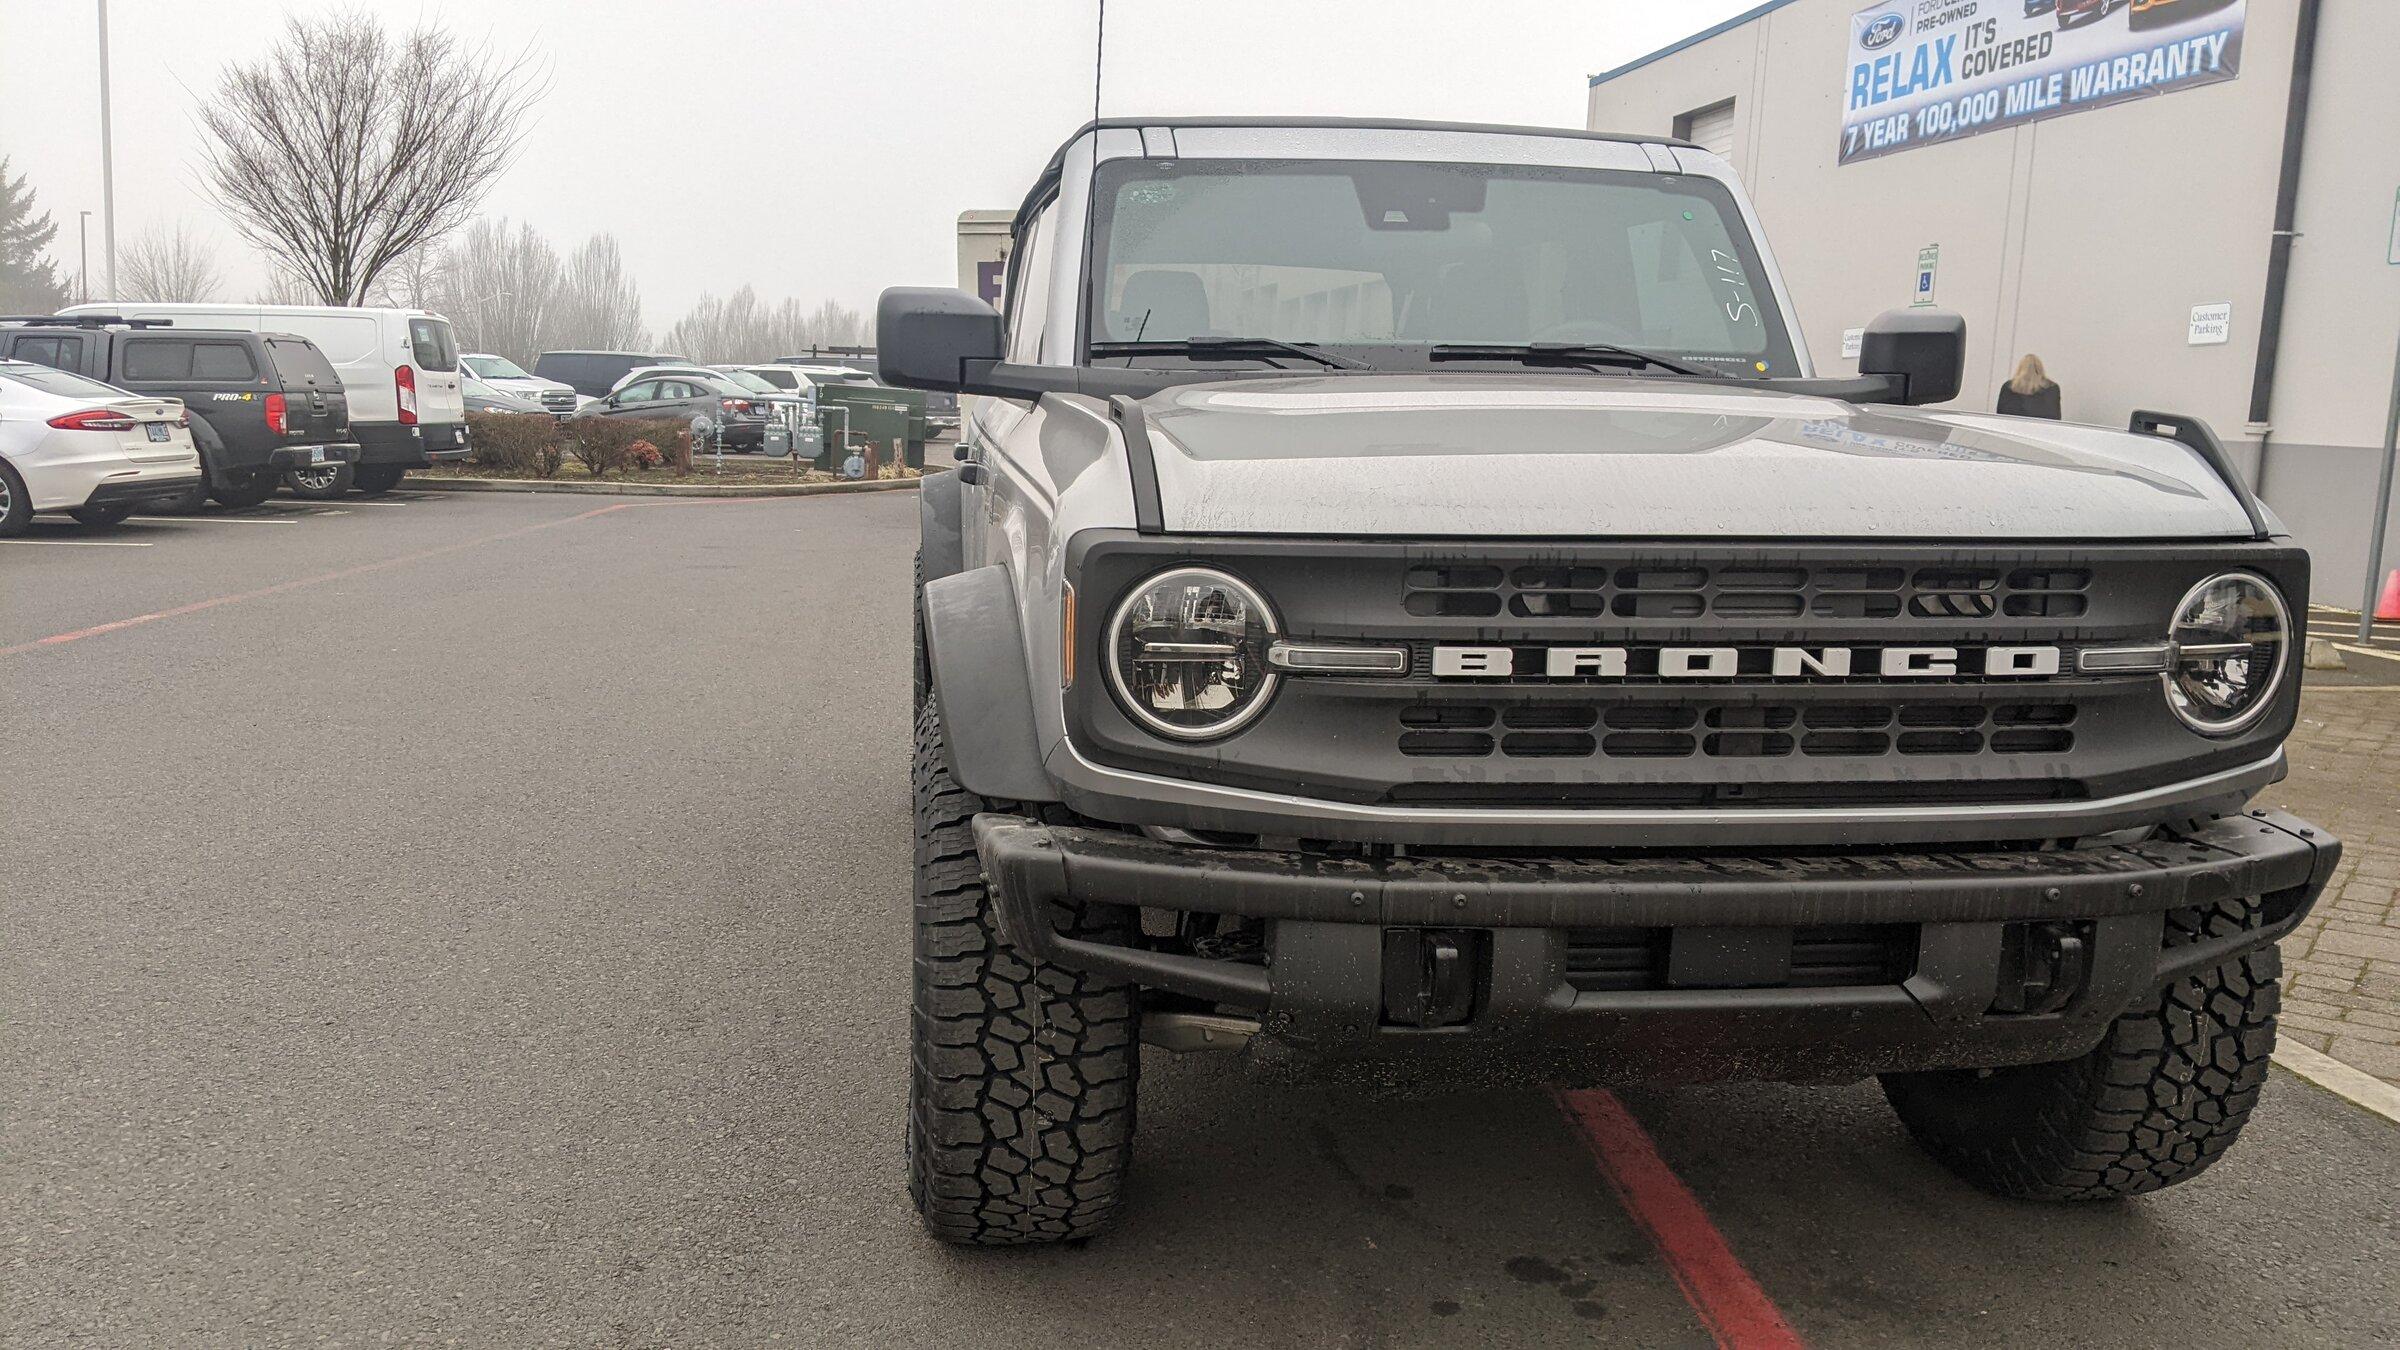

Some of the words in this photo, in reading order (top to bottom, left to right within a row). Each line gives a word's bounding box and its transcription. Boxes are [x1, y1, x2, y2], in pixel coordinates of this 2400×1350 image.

[1867, 18, 1898, 46] Ford
[1916, 2, 1978, 34] PRE-OWNED
[1964, 17, 1997, 51] IT'S
[1961, 30, 2053, 80] COVERED
[1850, 34, 1957, 110] RELAX
[1847, 125, 1859, 154] 7
[1863, 113, 1910, 150] YEAR
[1916, 89, 1999, 137] 100,000
[2004, 73, 2064, 116] MILE
[2069, 31, 2229, 101] WARRANTY
[1711, 249, 1758, 327] S-117
[2192, 312, 2228, 322] Customer
[2194, 323, 2223, 336] Parking
[1432, 645, 2061, 678] BRONCO
